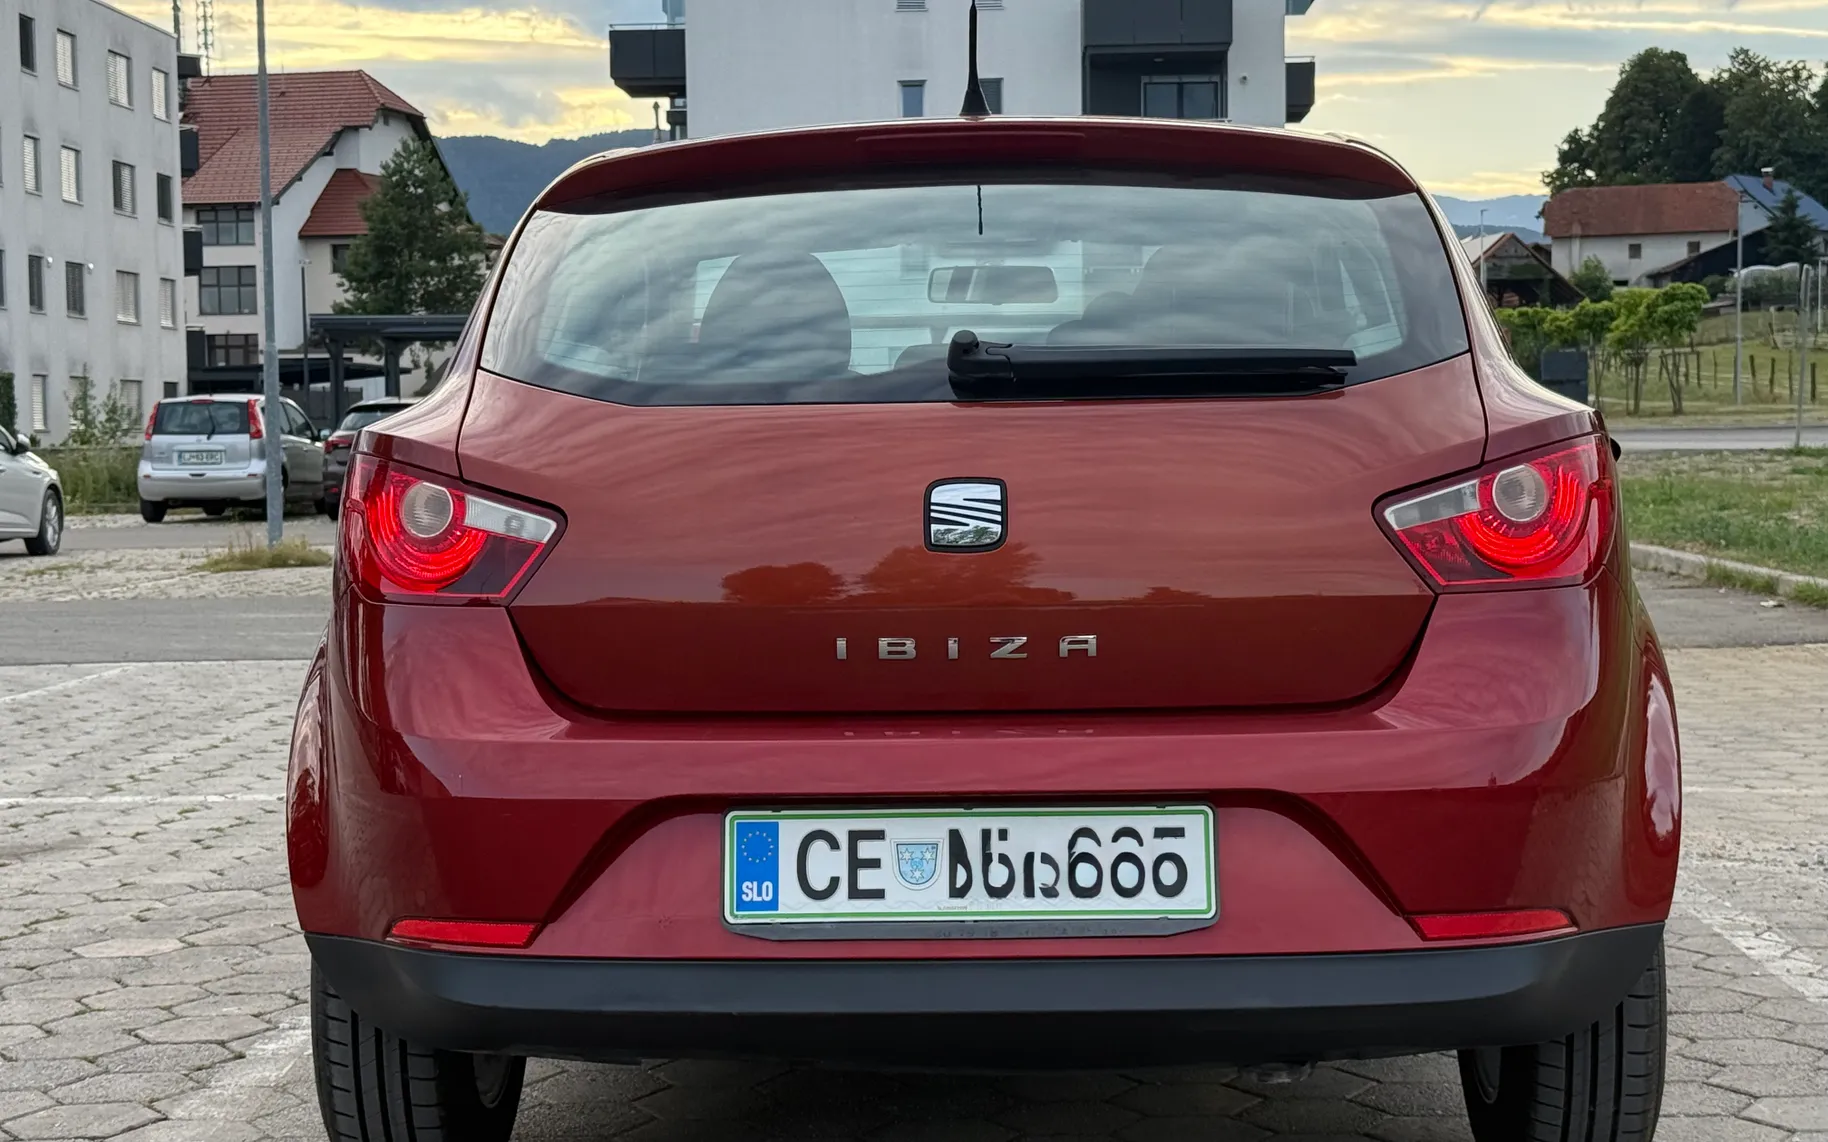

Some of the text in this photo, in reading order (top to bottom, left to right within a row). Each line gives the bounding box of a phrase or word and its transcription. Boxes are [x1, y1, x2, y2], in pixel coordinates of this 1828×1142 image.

[836, 634, 1097, 660] IBIZA
[796, 829, 886, 901] CE
[741, 881, 773, 902] SLO
